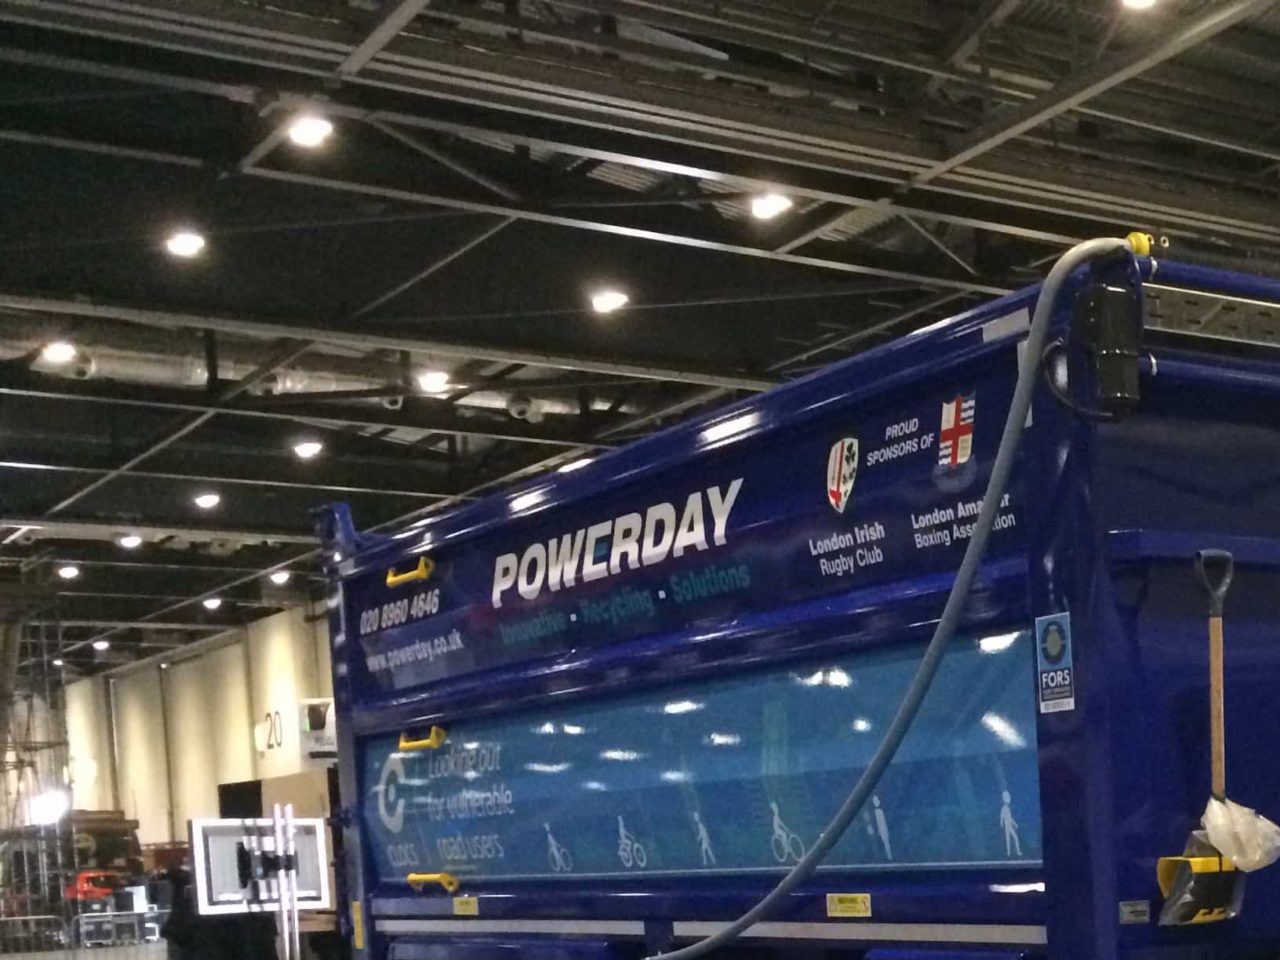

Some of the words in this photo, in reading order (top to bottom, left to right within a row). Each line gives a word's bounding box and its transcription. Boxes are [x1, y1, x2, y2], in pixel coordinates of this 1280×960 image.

[885, 418, 919, 441] PROUD
[866, 437, 918, 466] SPONSORS
[920, 433, 935, 449] OF
[911, 506, 954, 529] London
[492, 478, 744, 608] POWERDAY
[809, 530, 853, 556] London
[854, 522, 885, 545] Irish
[914, 528, 951, 549] Boxing
[820, 551, 855, 577] Rugby
[856, 546, 883, 567] Club
[669, 563, 750, 602] Solutions
[360, 607, 380, 635] 020
[381, 598, 408, 628] 8960
[410, 588, 439, 618] 4646
[1042, 669, 1070, 688] FORS
[265, 710, 283, 749] 20
